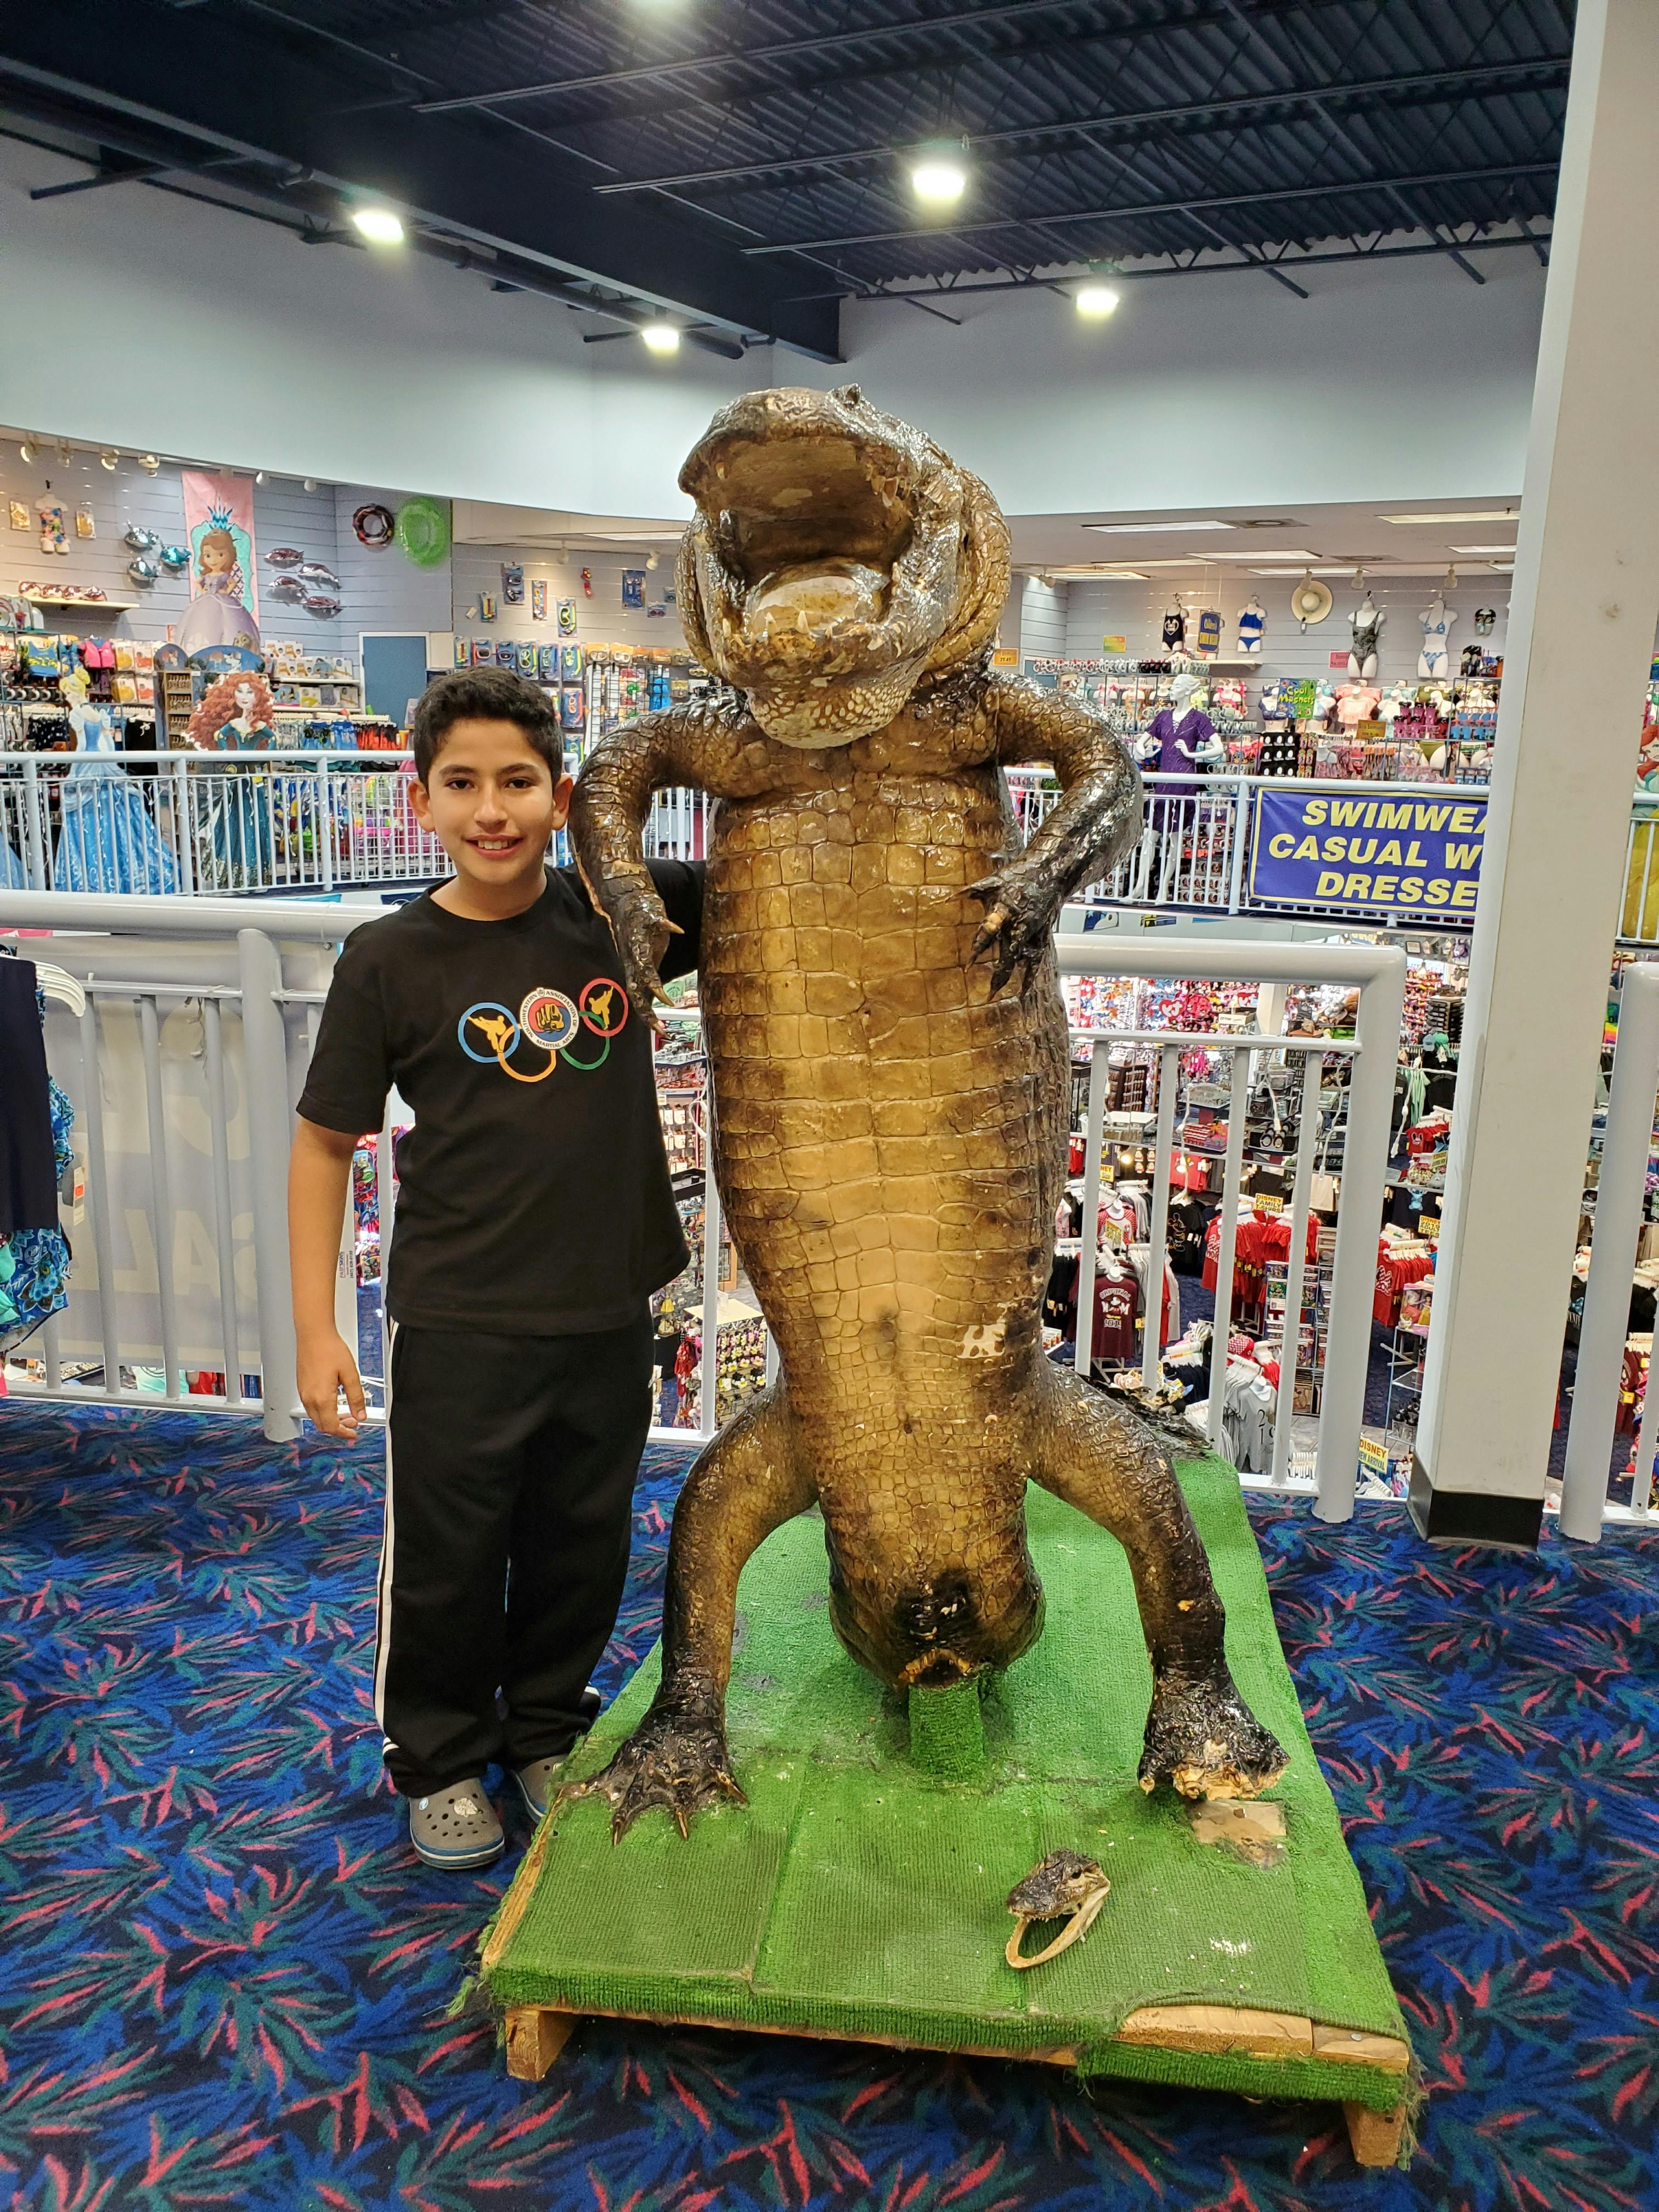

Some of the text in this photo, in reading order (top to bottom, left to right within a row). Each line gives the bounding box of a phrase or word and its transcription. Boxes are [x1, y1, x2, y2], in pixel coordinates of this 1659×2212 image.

[1287, 686, 1307, 696] Cool
[1278, 694, 1314, 705] Magnets
[1268, 833, 1483, 871] CASUAL W
[522, 994, 538, 1038] SOUTHWESTERN
[545, 991, 578, 1028] ASSOCIATION OF
[536, 1032, 574, 1048] MARTIAL ARTS
[1256, 1194, 1282, 1203] DISNEY
[1256, 1199, 1281, 1208] FAMILY
[1360, 1439, 1387, 1458] DISNEY
[1367, 1454, 1385, 1471] ARRIVAL
